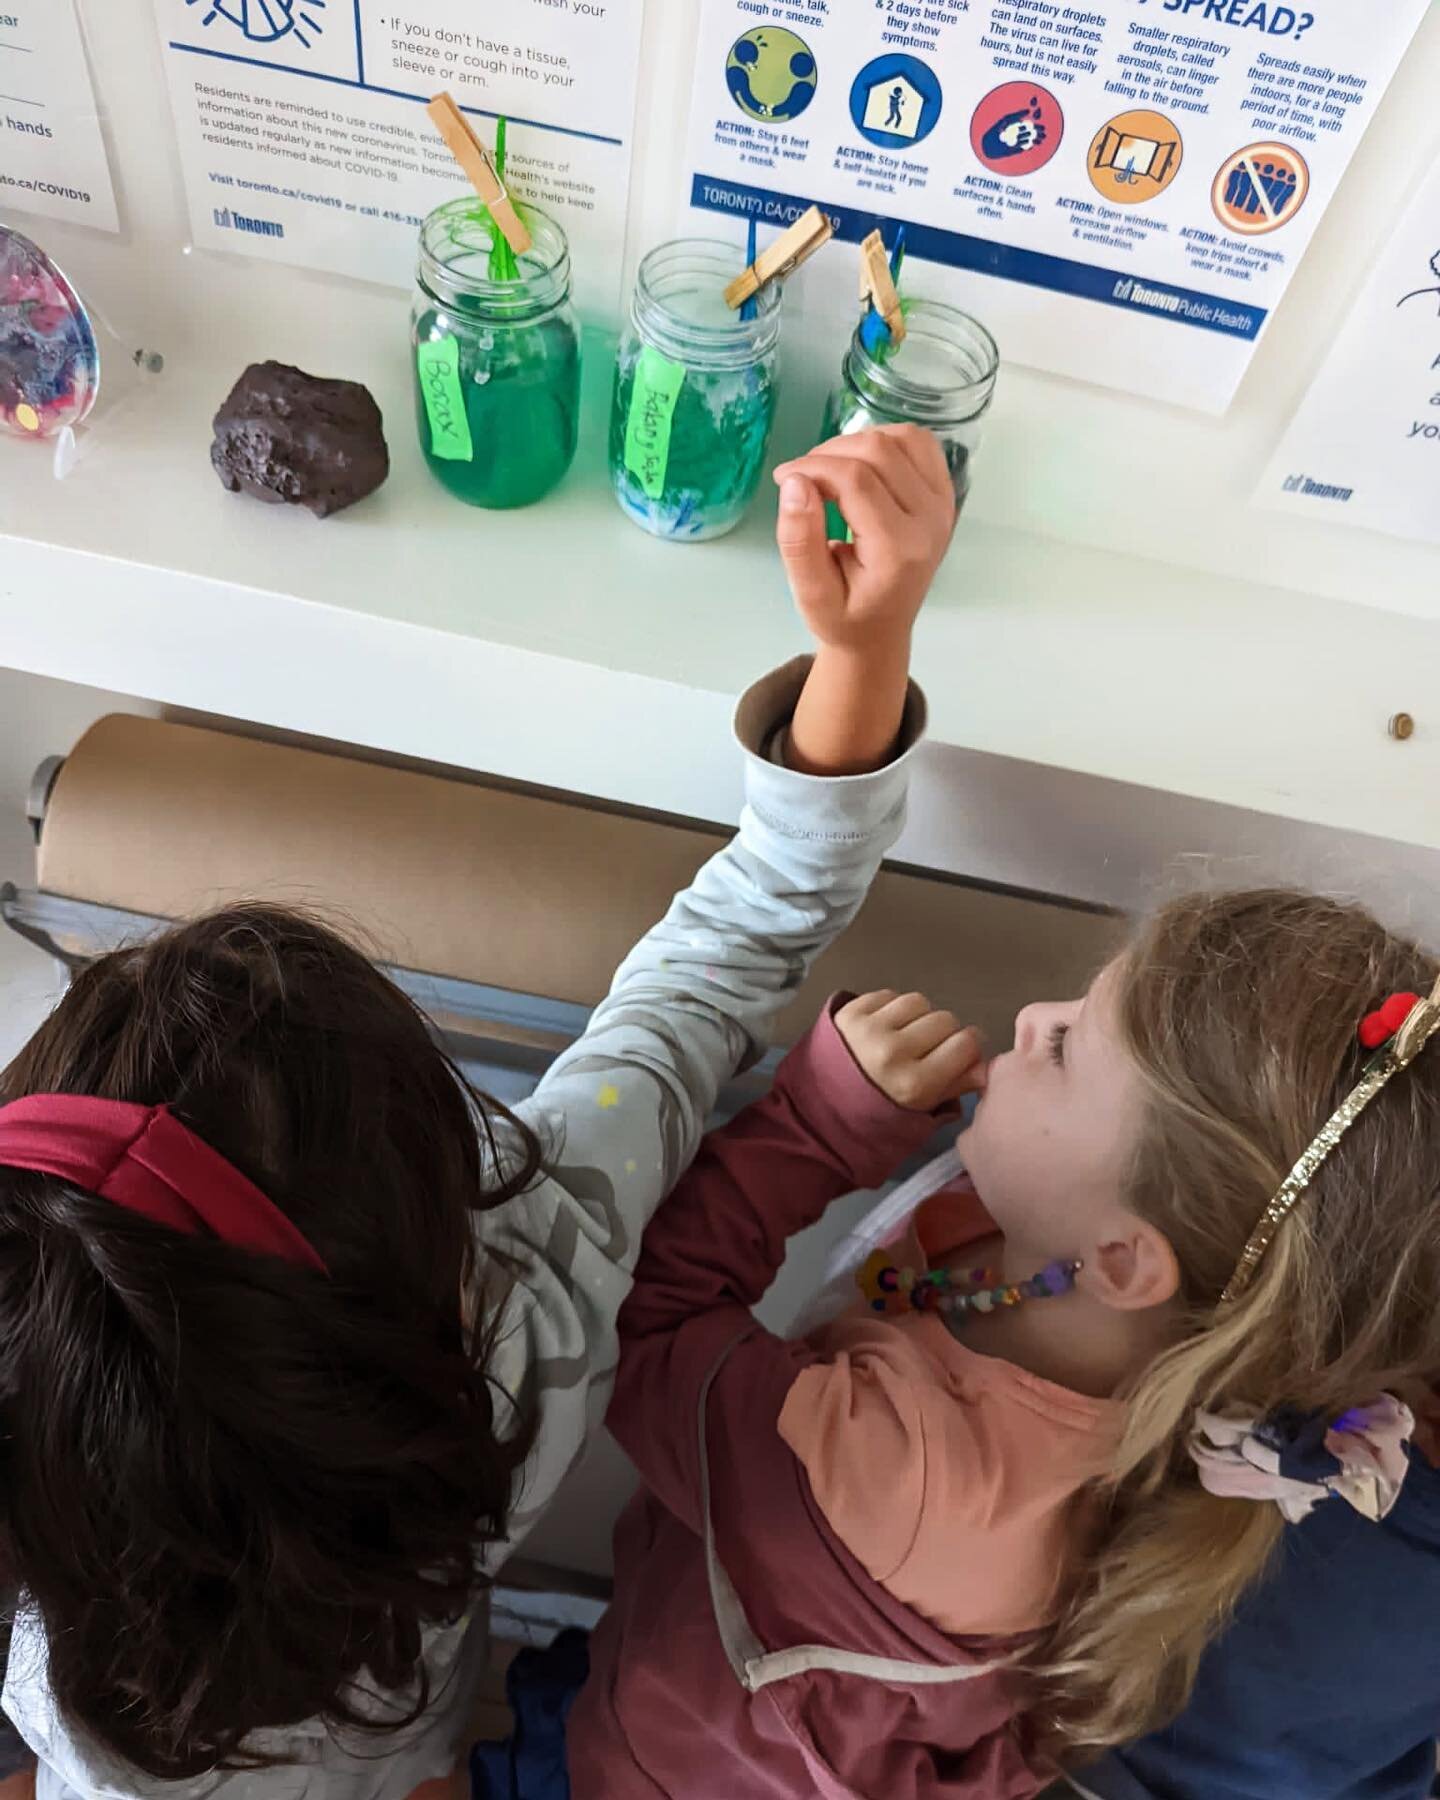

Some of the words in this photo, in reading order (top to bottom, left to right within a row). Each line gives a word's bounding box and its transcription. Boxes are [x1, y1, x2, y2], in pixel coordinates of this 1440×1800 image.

[573, 2, 606, 18] your
[737, 0, 769, 16] cough
[772, 8, 783, 18] or
[786, 11, 824, 28] sneeze.
[886, 0, 894, 11] 2
[896, 2, 922, 18] days
[923, 7, 958, 25] before
[948, 0, 970, 11] sick
[1062, 7, 1107, 27] droplets
[887, 15, 910, 32] they
[911, 22, 941, 37] show
[990, 22, 1009, 36] The
[1011, 28, 1037, 43] virus
[1039, 36, 1059, 48] can
[1061, 39, 1080, 53] live
[1082, 43, 1099, 57] for
[992, 9, 1011, 21] can
[1014, 11, 1038, 27] land
[1039, 20, 1053, 31] on
[1055, 24, 1104, 43] surfaces.
[1128, 22, 1171, 42] Smaller
[1171, 34, 1231, 58] respiratory
[391, 17, 401, 31] If
[404, 23, 431, 38] you
[434, 28, 472, 48] don't
[476, 36, 510, 56] have
[513, 48, 522, 58] a
[527, 48, 570, 70] tissue,
[881, 32, 938, 52] symptoms.
[980, 37, 1013, 54] hours,
[1015, 44, 1034, 58] but
[1035, 49, 1045, 60] is
[1047, 53, 1065, 65] not
[1066, 58, 1098, 74] easily
[1133, 40, 1178, 62] droplets,
[1181, 53, 1215, 68] called
[392, 39, 440, 59] sneeze
[444, 51, 459, 63] or
[464, 56, 507, 74] cough
[512, 63, 539, 80] into
[544, 72, 575, 88] your
[392, 56, 436, 76] sleeve
[439, 69, 454, 80] or
[458, 73, 489, 88] arm.
[992, 56, 1029, 72] spread
[1031, 63, 1051, 77] this
[1053, 70, 1076, 85] way.
[1117, 54, 1163, 75] aerosols,
[1166, 65, 1187, 78] can
[1188, 68, 1220, 85] linger
[1256, 52, 1302, 73] Spreads
[1303, 66, 1336, 83] easily
[1337, 74, 1367, 89] when
[1104, 80, 1137, 100] falling
[1139, 88, 1150, 100] to
[1152, 91, 1169, 105] the
[1170, 98, 1211, 114] ground.
[1121, 68, 1132, 81] in
[1134, 72, 1151, 85] the
[1153, 77, 1169, 89] air
[1170, 80, 1204, 98] before
[1247, 67, 1276, 83] there
[1277, 76, 1295, 88] are
[1296, 81, 1325, 95] more
[1325, 88, 1363, 105] people
[194, 82, 251, 103] Residents
[253, 96, 272, 108] are
[275, 100, 329, 120] reminded
[331, 112, 344, 123] to
[346, 117, 366, 128] use
[1250, 83, 1292, 105] indoors,
[1295, 94, 1312, 108] for
[1312, 101, 1321, 110] a
[1321, 101, 1346, 119] long
[6, 115, 53, 138] hands
[197, 98, 263, 123] information
[265, 114, 299, 131] about
[302, 121, 323, 134] this
[325, 128, 349, 140] new
[1240, 99, 1277, 115] period
[1276, 107, 1290, 118] of
[1290, 109, 1315, 128] time,
[1318, 119, 1342, 133] with
[1251, 118, 1278, 131] poor
[1278, 124, 1316, 142] airflow.
[200, 115, 210, 128] is
[212, 120, 260, 137] updated
[261, 128, 311, 149] regularly
[313, 141, 327, 152] as
[329, 144, 352, 156] new
[355, 148, 419, 172] information
[715, 132, 738, 147] from
[739, 140, 770, 154] others
[782, 150, 807, 161] wear
[716, 120, 755, 137] ACTION:
[758, 129, 779, 144] Stay
[790, 136, 810, 149] feet
[202, 133, 254, 151] residents
[256, 142, 308, 163] informed
[309, 154, 342, 170] about
[511, 154, 555, 170] sources
[558, 163, 570, 173] of
[739, 153, 746, 162] a
[836, 146, 876, 163] ACTION:
[878, 155, 900, 170] Stay
[902, 160, 929, 175] home
[208, 172, 234, 186] Visit
[236, 178, 342, 208] toronto.ca/covid19
[345, 203, 357, 211] or
[360, 207, 379, 217] call
[553, 180, 595, 194] website
[856, 179, 873, 189] are
[899, 173, 907, 183] if
[908, 177, 926, 187] you
[964, 175, 1003, 193] ACTION:
[1005, 185, 1033, 199] Clean
[526, 187, 538, 199] to
[540, 190, 565, 204] help
[567, 195, 594, 210] keep
[953, 188, 994, 204] surfaces
[1006, 199, 1037, 214] hands
[1056, 197, 1095, 214] ACTION:
[1097, 206, 1122, 221] Open
[1112, 225, 1147, 240] airflow
[1179, 227, 1219, 245] ACTION:
[1219, 237, 1248, 253] Avoid
[1185, 242, 1210, 258] keep
[1211, 249, 1233, 263] trips
[1233, 256, 1261, 270] short
[1190, 259, 1215, 271] wear
[1215, 265, 1223, 274] a
[1177, 297, 1213, 323] Public
[1212, 307, 1254, 332] Health
